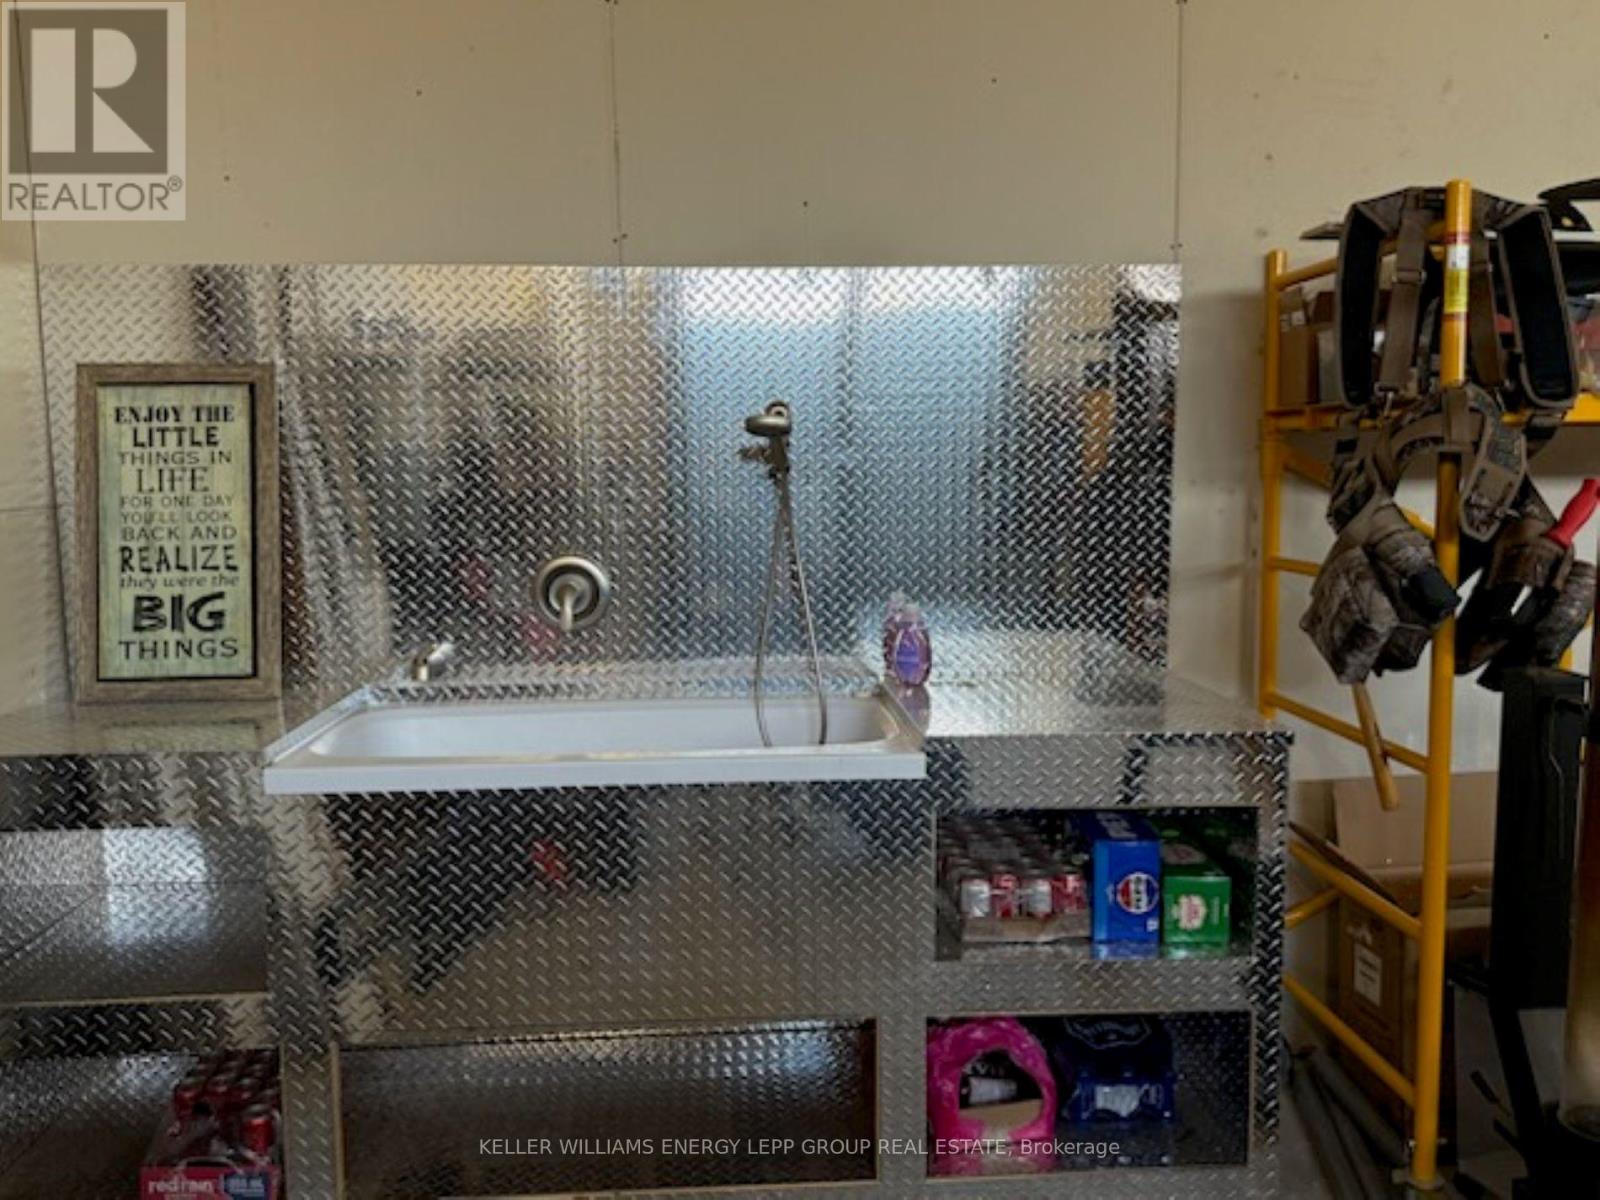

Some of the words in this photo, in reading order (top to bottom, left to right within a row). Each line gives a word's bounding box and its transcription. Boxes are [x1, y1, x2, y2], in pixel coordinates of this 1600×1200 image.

[114, 405, 182, 422] ENJOY
[192, 404, 235, 422] THE
[133, 426, 220, 447] LITTLE
[119, 451, 200, 465] THINGS
[210, 450, 232, 464] IN
[137, 467, 210, 493] LIFE
[120, 495, 152, 508] FOR
[161, 495, 192, 508] ONE
[203, 494, 233, 507] DAY
[186, 510, 232, 523] LOOK
[122, 526, 180, 541] BACK
[191, 525, 237, 540] AND
[120, 546, 239, 573] REALIZE
[120, 575, 156, 589] they
[163, 576, 206, 588] were
[211, 573, 239, 587] the
[133, 592, 226, 632] BIG
[118, 638, 239, 660] THINGS
